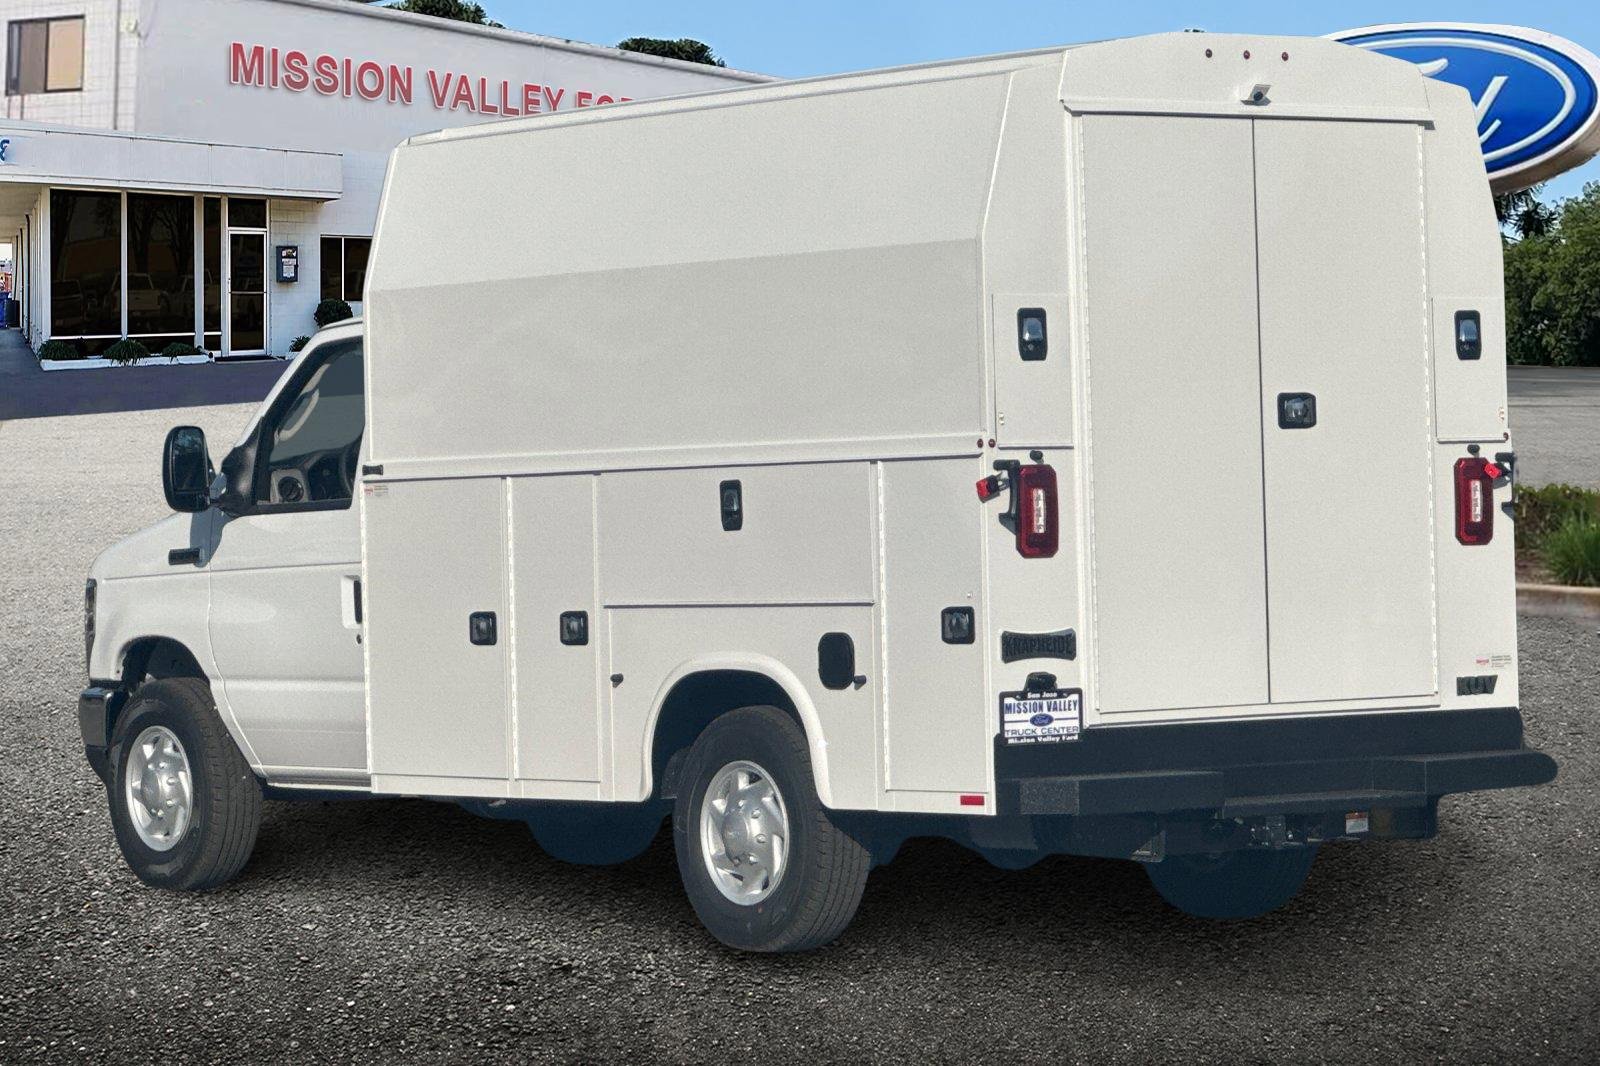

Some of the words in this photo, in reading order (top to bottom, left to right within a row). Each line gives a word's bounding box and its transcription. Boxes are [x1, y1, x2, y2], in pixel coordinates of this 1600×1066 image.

[230, 41, 412, 105] MISSION
[427, 69, 565, 117] VALLEY
[1004, 701, 1044, 714] MISSION
[1046, 699, 1078, 712] VALLEY
[1005, 728, 1037, 736] TRUCK
[1041, 725, 1079, 735] CENTER
